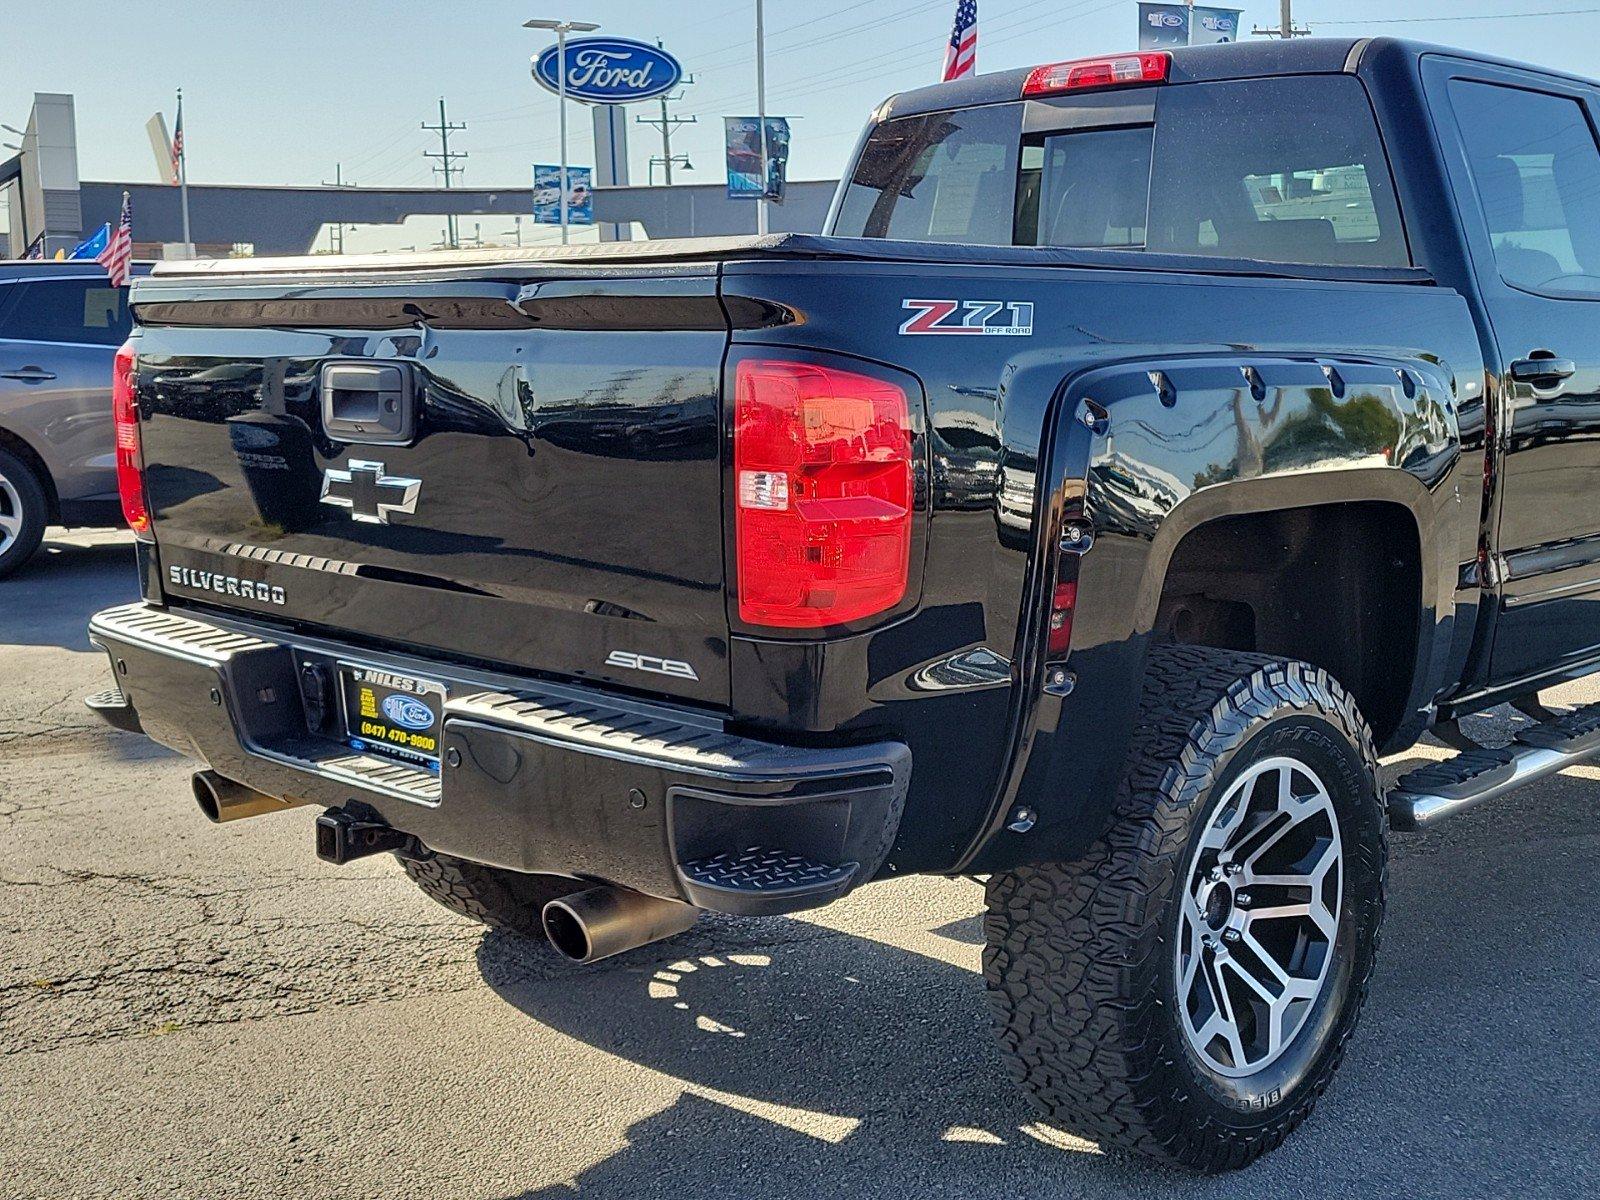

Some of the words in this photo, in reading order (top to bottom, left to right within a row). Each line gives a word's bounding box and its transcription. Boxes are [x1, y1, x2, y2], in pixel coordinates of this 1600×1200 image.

[568, 49, 654, 89] Ford
[899, 299, 1034, 335] Z71
[169, 565, 286, 605] SILVERADO
[364, 670, 414, 692] NILES
[408, 707, 428, 721] Ford
[361, 722, 386, 739] (847)
[388, 729, 436, 751] 470-9800
